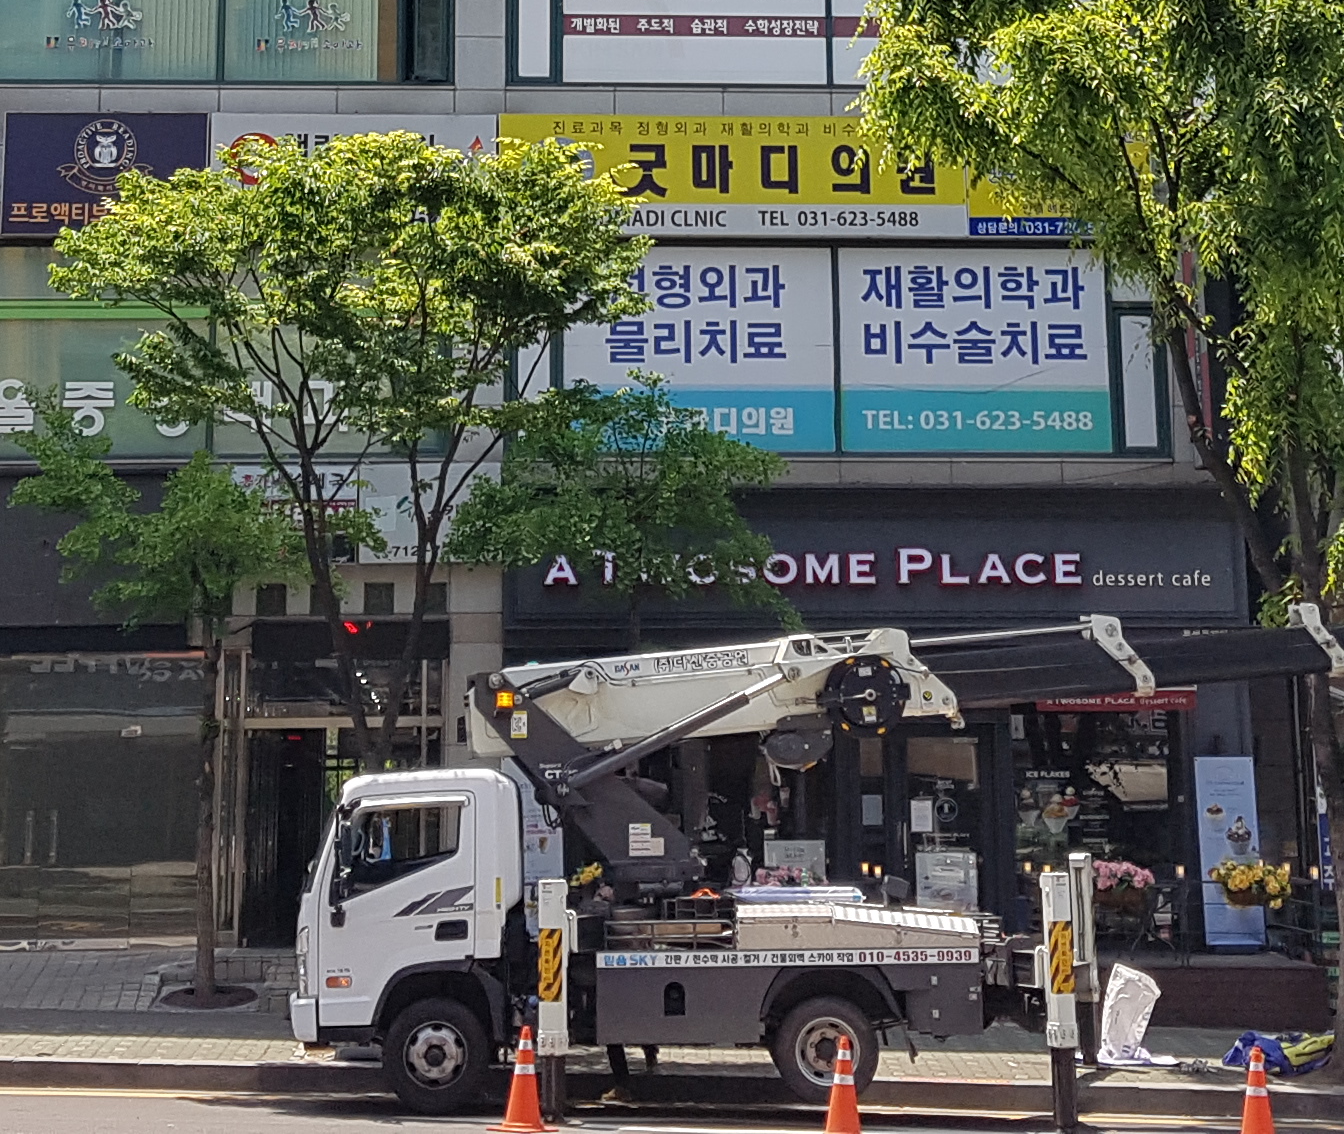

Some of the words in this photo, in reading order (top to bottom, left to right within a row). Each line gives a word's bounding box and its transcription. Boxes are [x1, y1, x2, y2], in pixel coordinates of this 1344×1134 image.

[570, 17, 621, 35] 개별화된
[636, 18, 675, 35] 주도적
[690, 18, 728, 36] 습관적
[743, 19, 820, 37] 수학성장전략
[552, 120, 623, 137] 진료과목
[636, 120, 708, 138] 정형외과
[720, 121, 811, 138] 재활의학과
[9, 201, 109, 224] 프로액티브
[758, 210, 789, 227] TEL
[798, 210, 919, 227] 031-623-5488
[861, 264, 1085, 311] 재활의학과
[604, 320, 788, 365] 물리치료
[862, 320, 1089, 365] 비수술치료
[862, 410, 914, 431] TEL:
[919, 410, 1094, 432] 031-623-5488
[897, 546, 1082, 586] PLACE
[1091, 570, 1163, 588] dessert
[1171, 569, 1212, 588] cafe
[1106, 697, 1136, 705] PLACE
[1170, 697, 1187, 705] cafe
[1025, 770, 1039, 778] ICE
[665, 954, 683, 965] 간판
